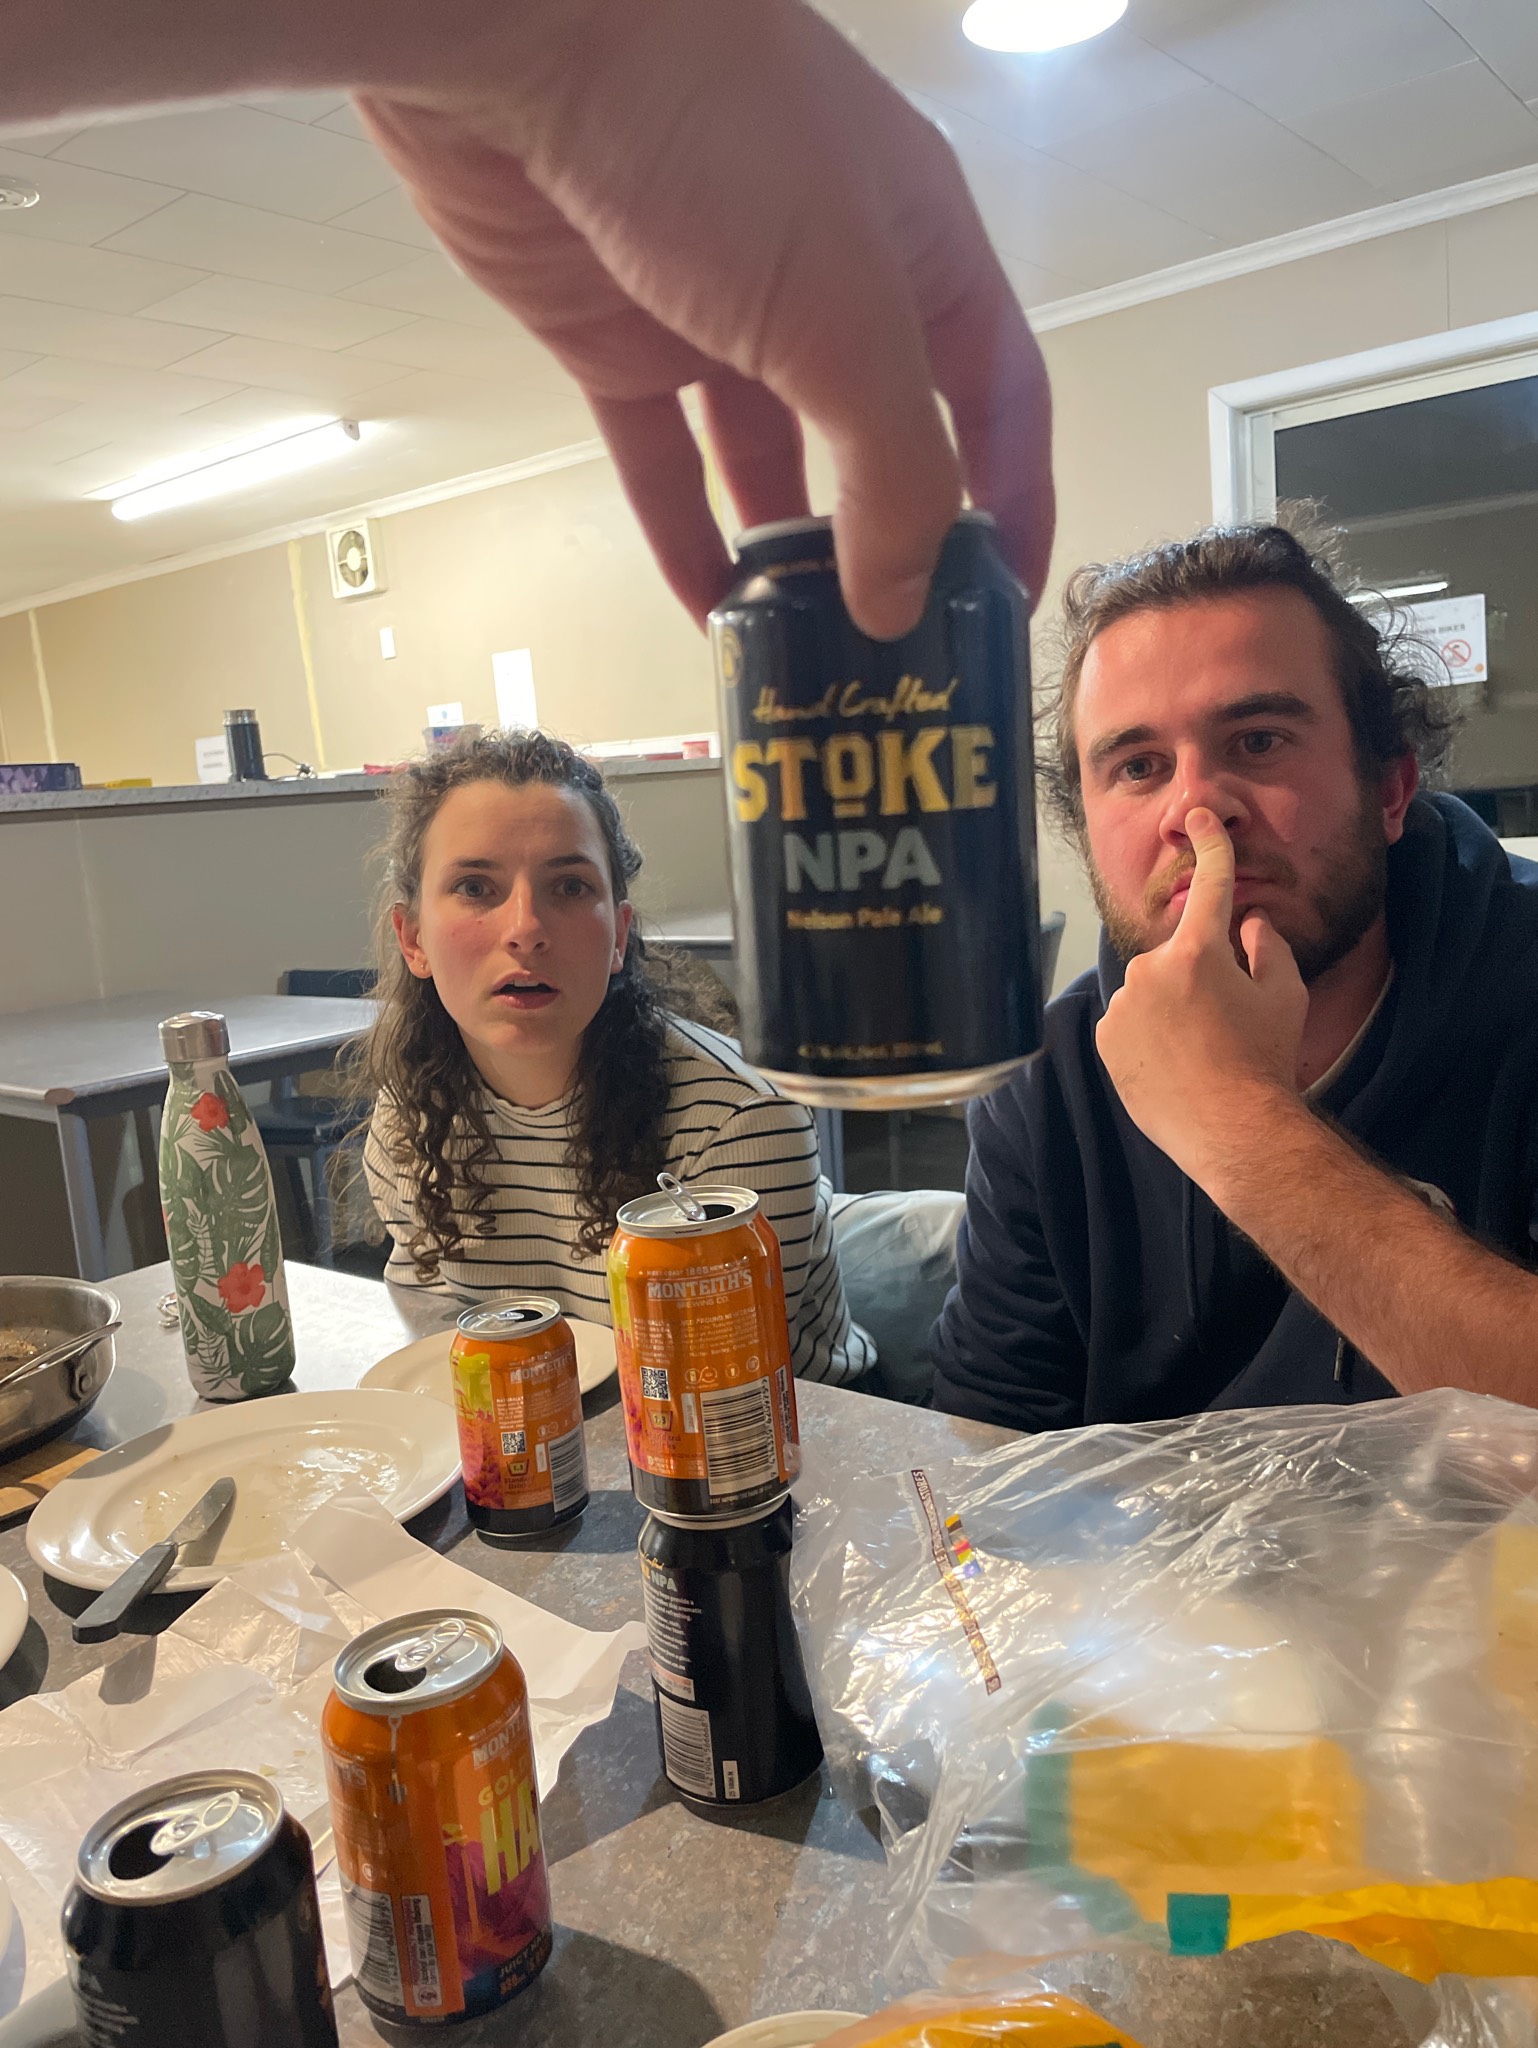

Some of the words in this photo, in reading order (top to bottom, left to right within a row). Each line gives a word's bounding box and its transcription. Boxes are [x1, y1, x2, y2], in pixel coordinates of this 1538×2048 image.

[753, 681, 838, 724] Hand
[839, 673, 961, 723] Crafted
[733, 723, 998, 822] STOKE
[783, 827, 942, 893] NPA
[908, 902, 944, 925] Ale
[647, 1269, 752, 1299] MONTEITH'S
[911, 1470, 931, 1500] STORES
[650, 1569, 678, 1592] NPA
[499, 1949, 529, 1977] JUICY
